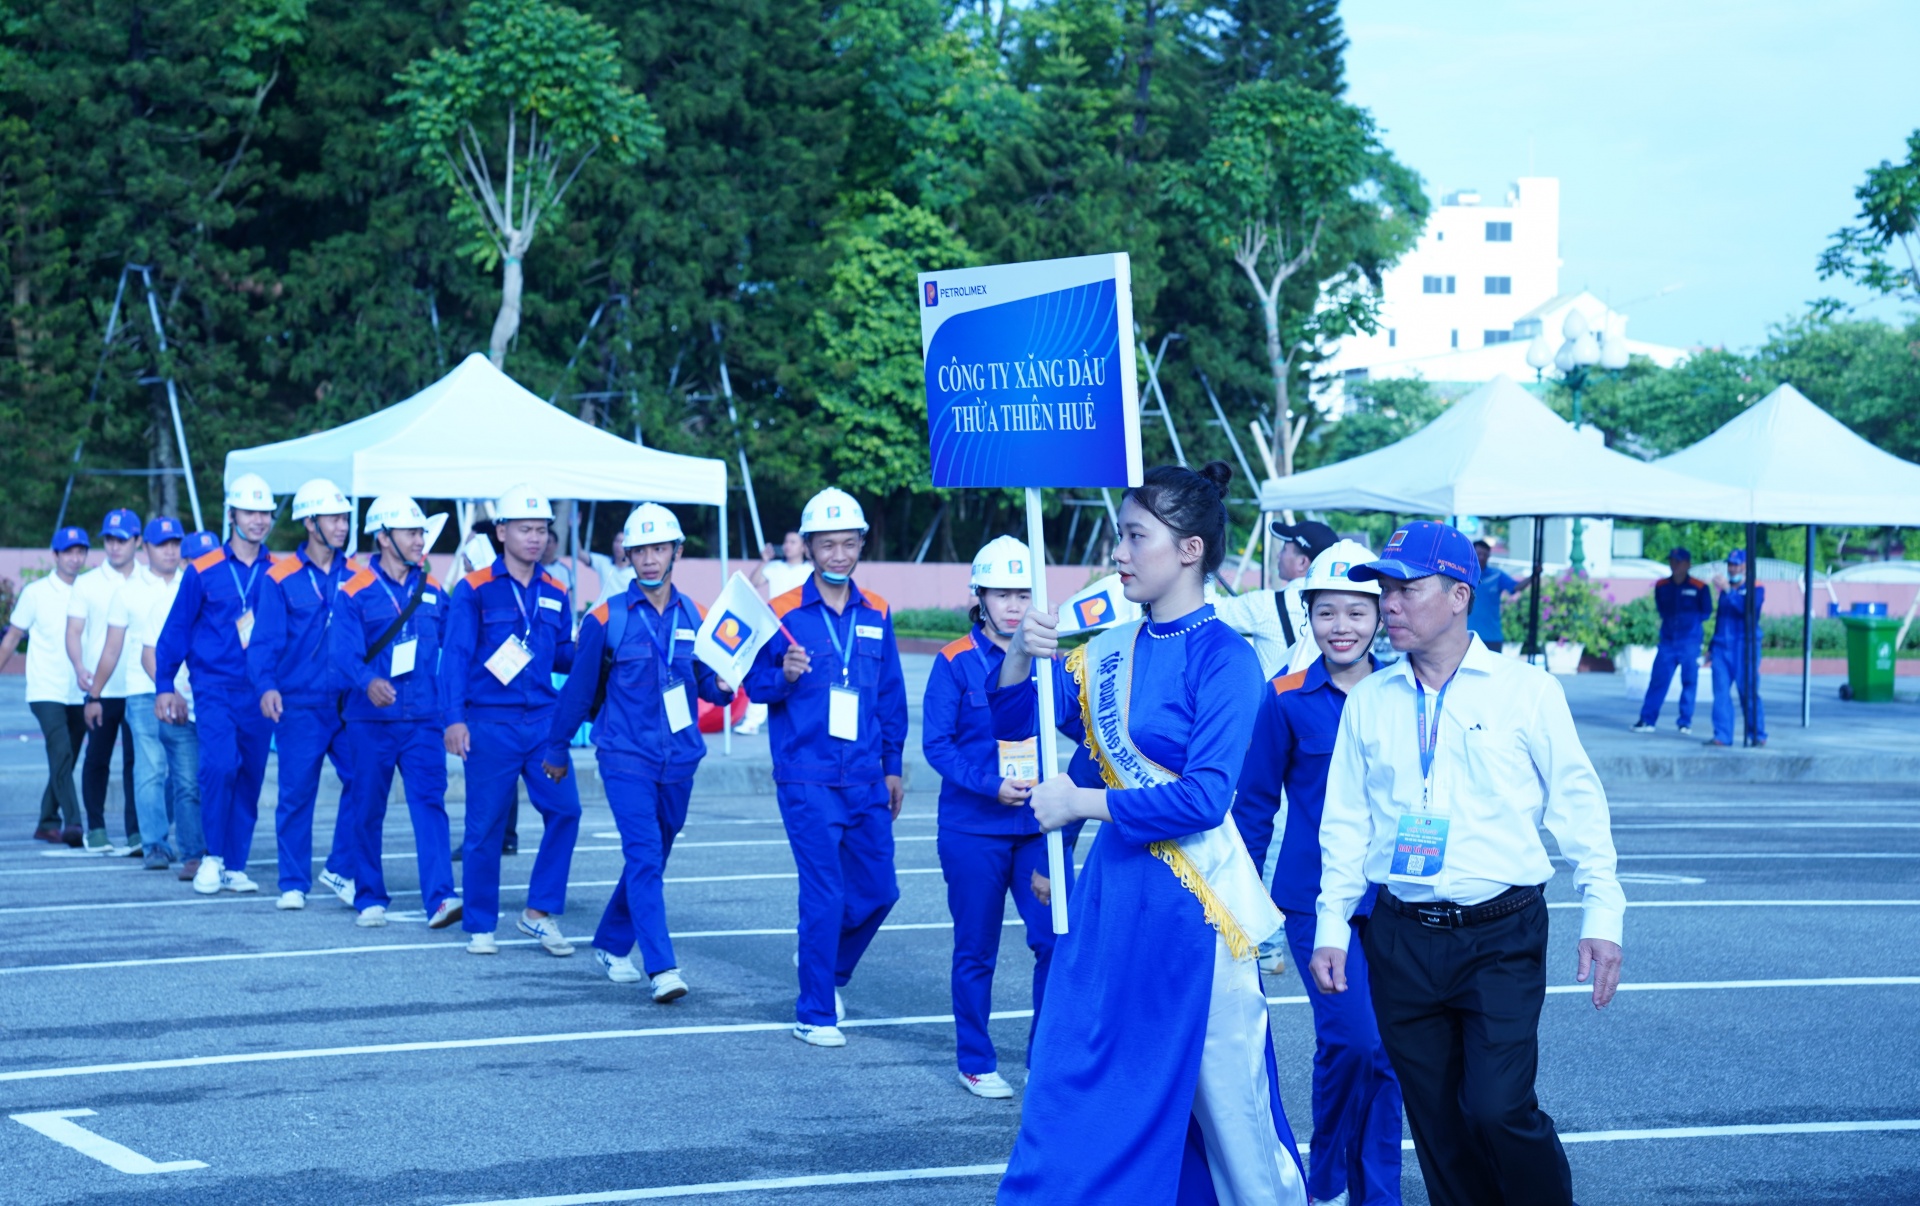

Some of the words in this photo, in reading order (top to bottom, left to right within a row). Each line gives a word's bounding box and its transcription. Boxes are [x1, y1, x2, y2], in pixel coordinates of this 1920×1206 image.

[940, 285, 987, 298] PETROLIMEX
[938, 356, 985, 392] CÔNG
[988, 361, 1011, 390] TY
[1015, 352, 1064, 389] XĂNG
[1068, 349, 1106, 386] DẦU
[952, 397, 999, 433] THỪA
[1000, 394, 1054, 431] THIÊN
